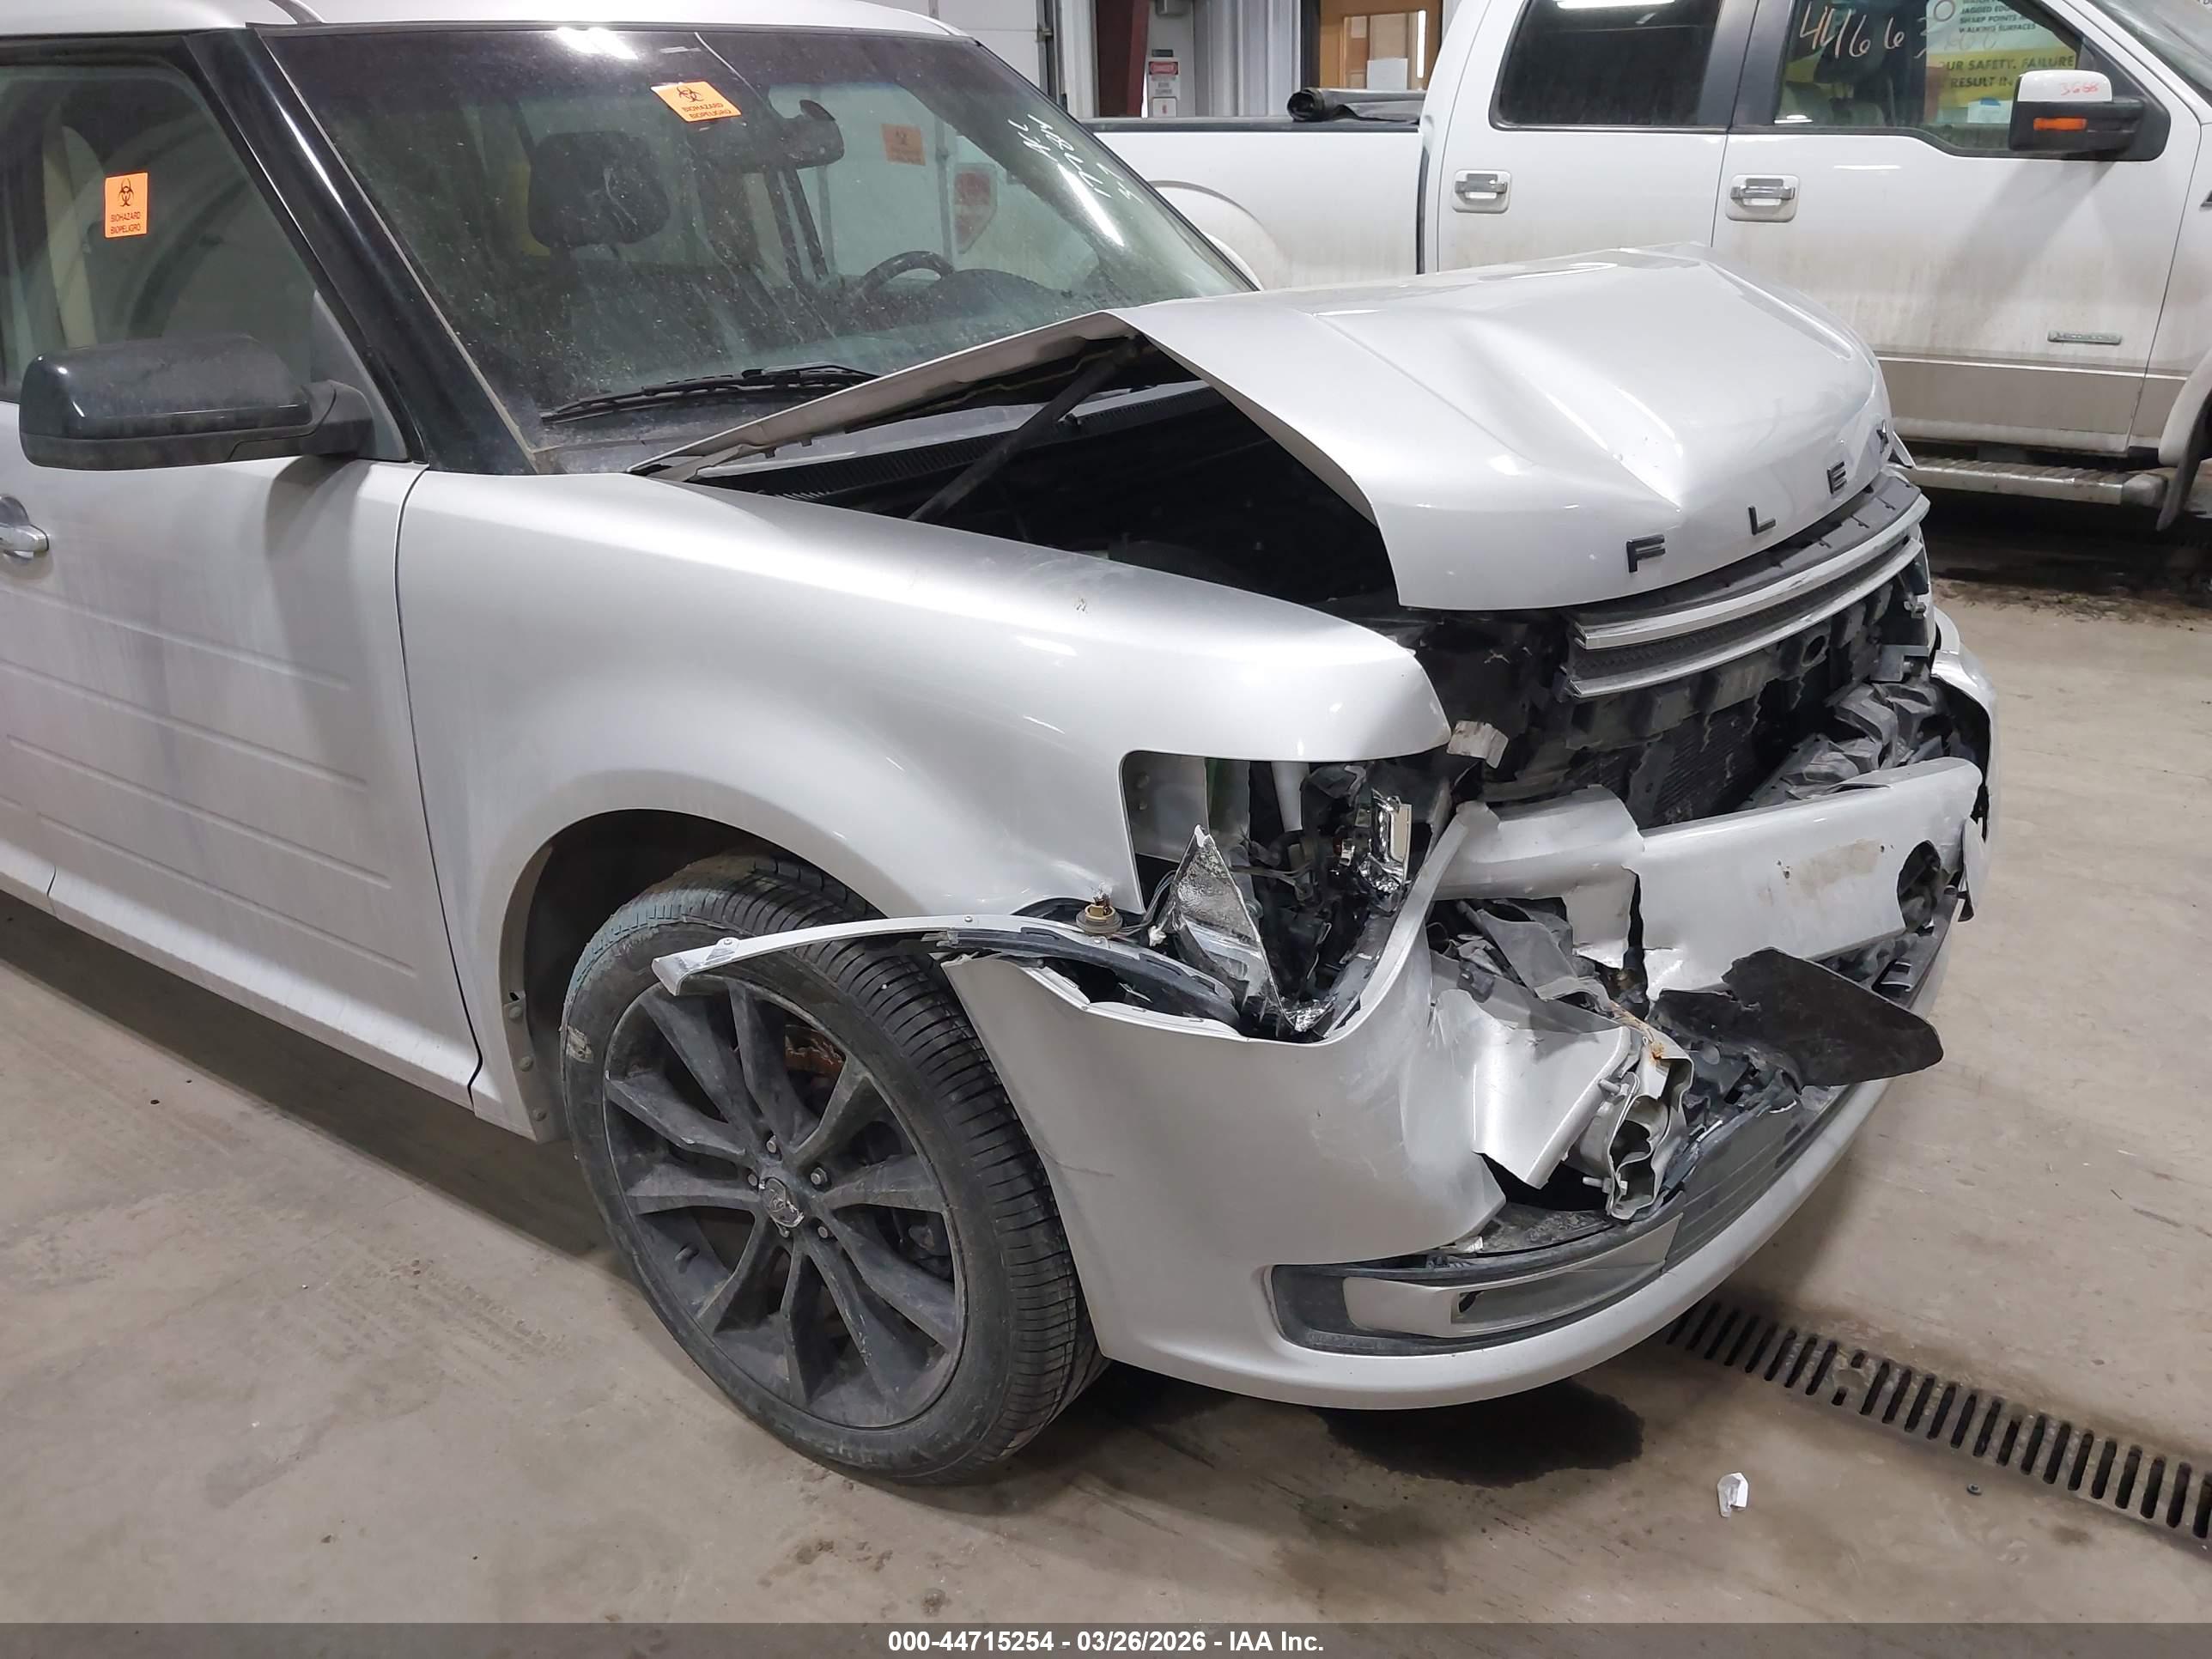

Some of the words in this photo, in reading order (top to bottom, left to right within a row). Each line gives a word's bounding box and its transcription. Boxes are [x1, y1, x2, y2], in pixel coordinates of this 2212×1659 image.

[1998, 23, 2036, 32] SURFACES
[1968, 59, 2017, 70] SAFETY.
[2021, 56, 2075, 69] FAILURE
[1950, 76, 1996, 88] RESULT
[681, 102, 725, 112] BIOHAZARD
[688, 109, 732, 119] BIOPELIGRO
[110, 211, 141, 222] BIOHAZARD
[110, 223, 142, 234] BIOPELIGRO
